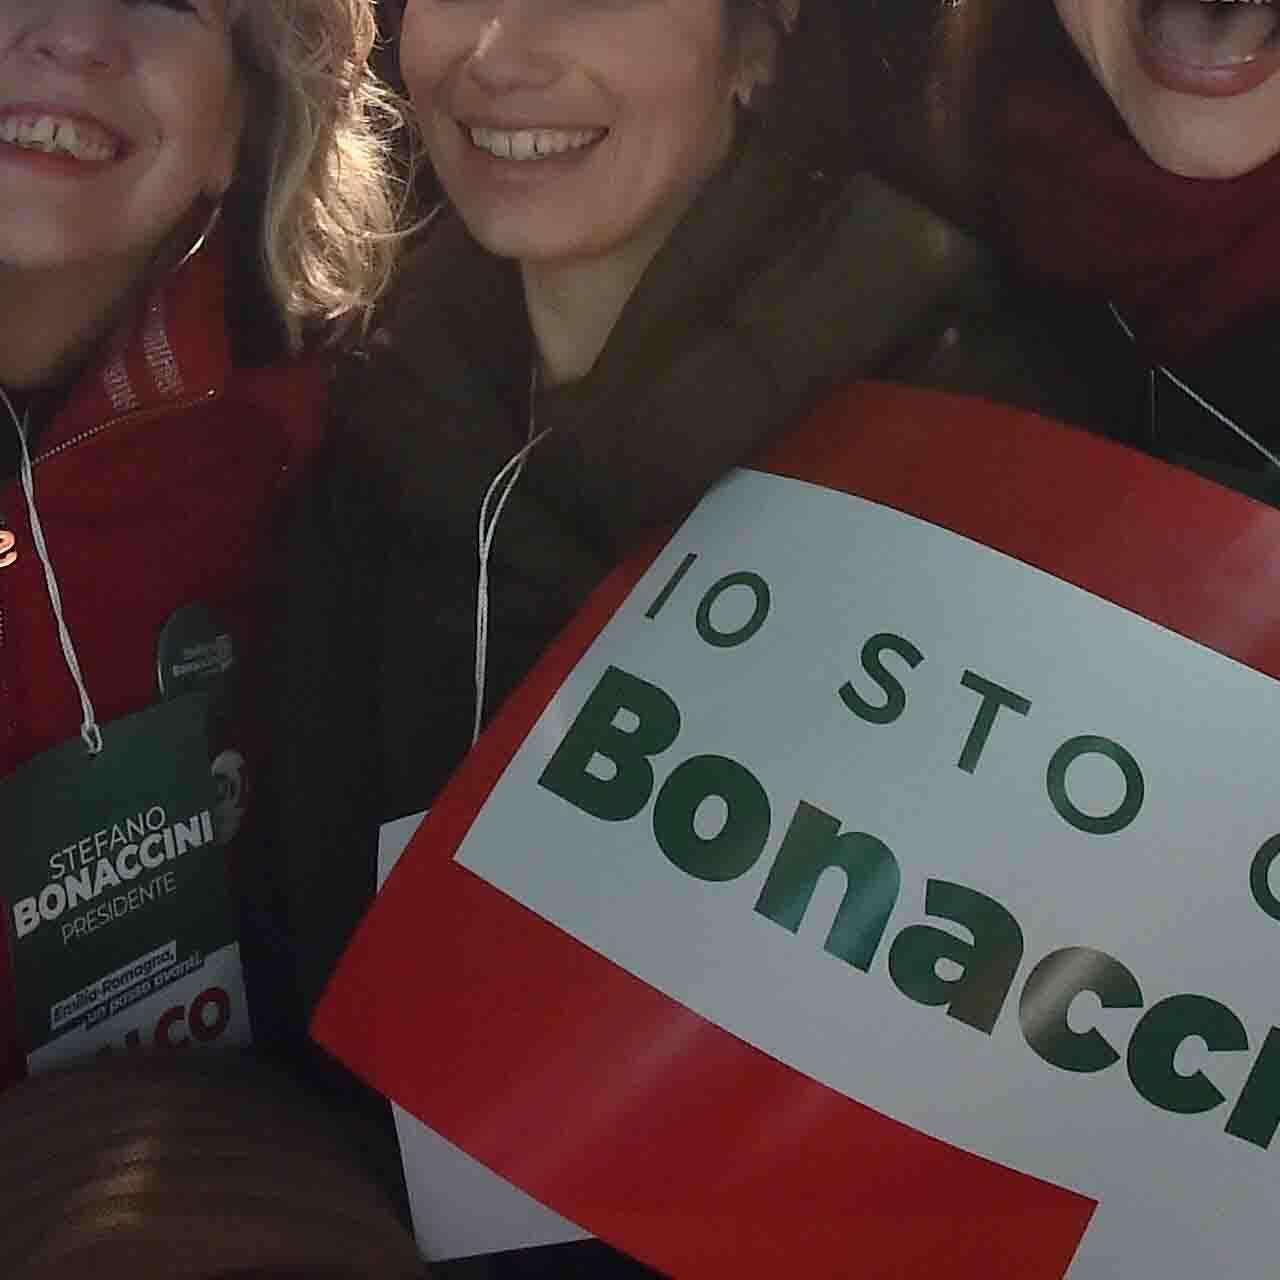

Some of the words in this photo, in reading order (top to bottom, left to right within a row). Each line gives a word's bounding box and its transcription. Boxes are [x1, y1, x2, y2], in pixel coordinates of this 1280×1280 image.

[644, 552, 771, 648] IO
[838, 632, 1145, 836] STO
[12, 811, 216, 939] BONACCINI
[48, 805, 166, 879] STEFANO
[61, 871, 177, 945] PRESIDENTE
